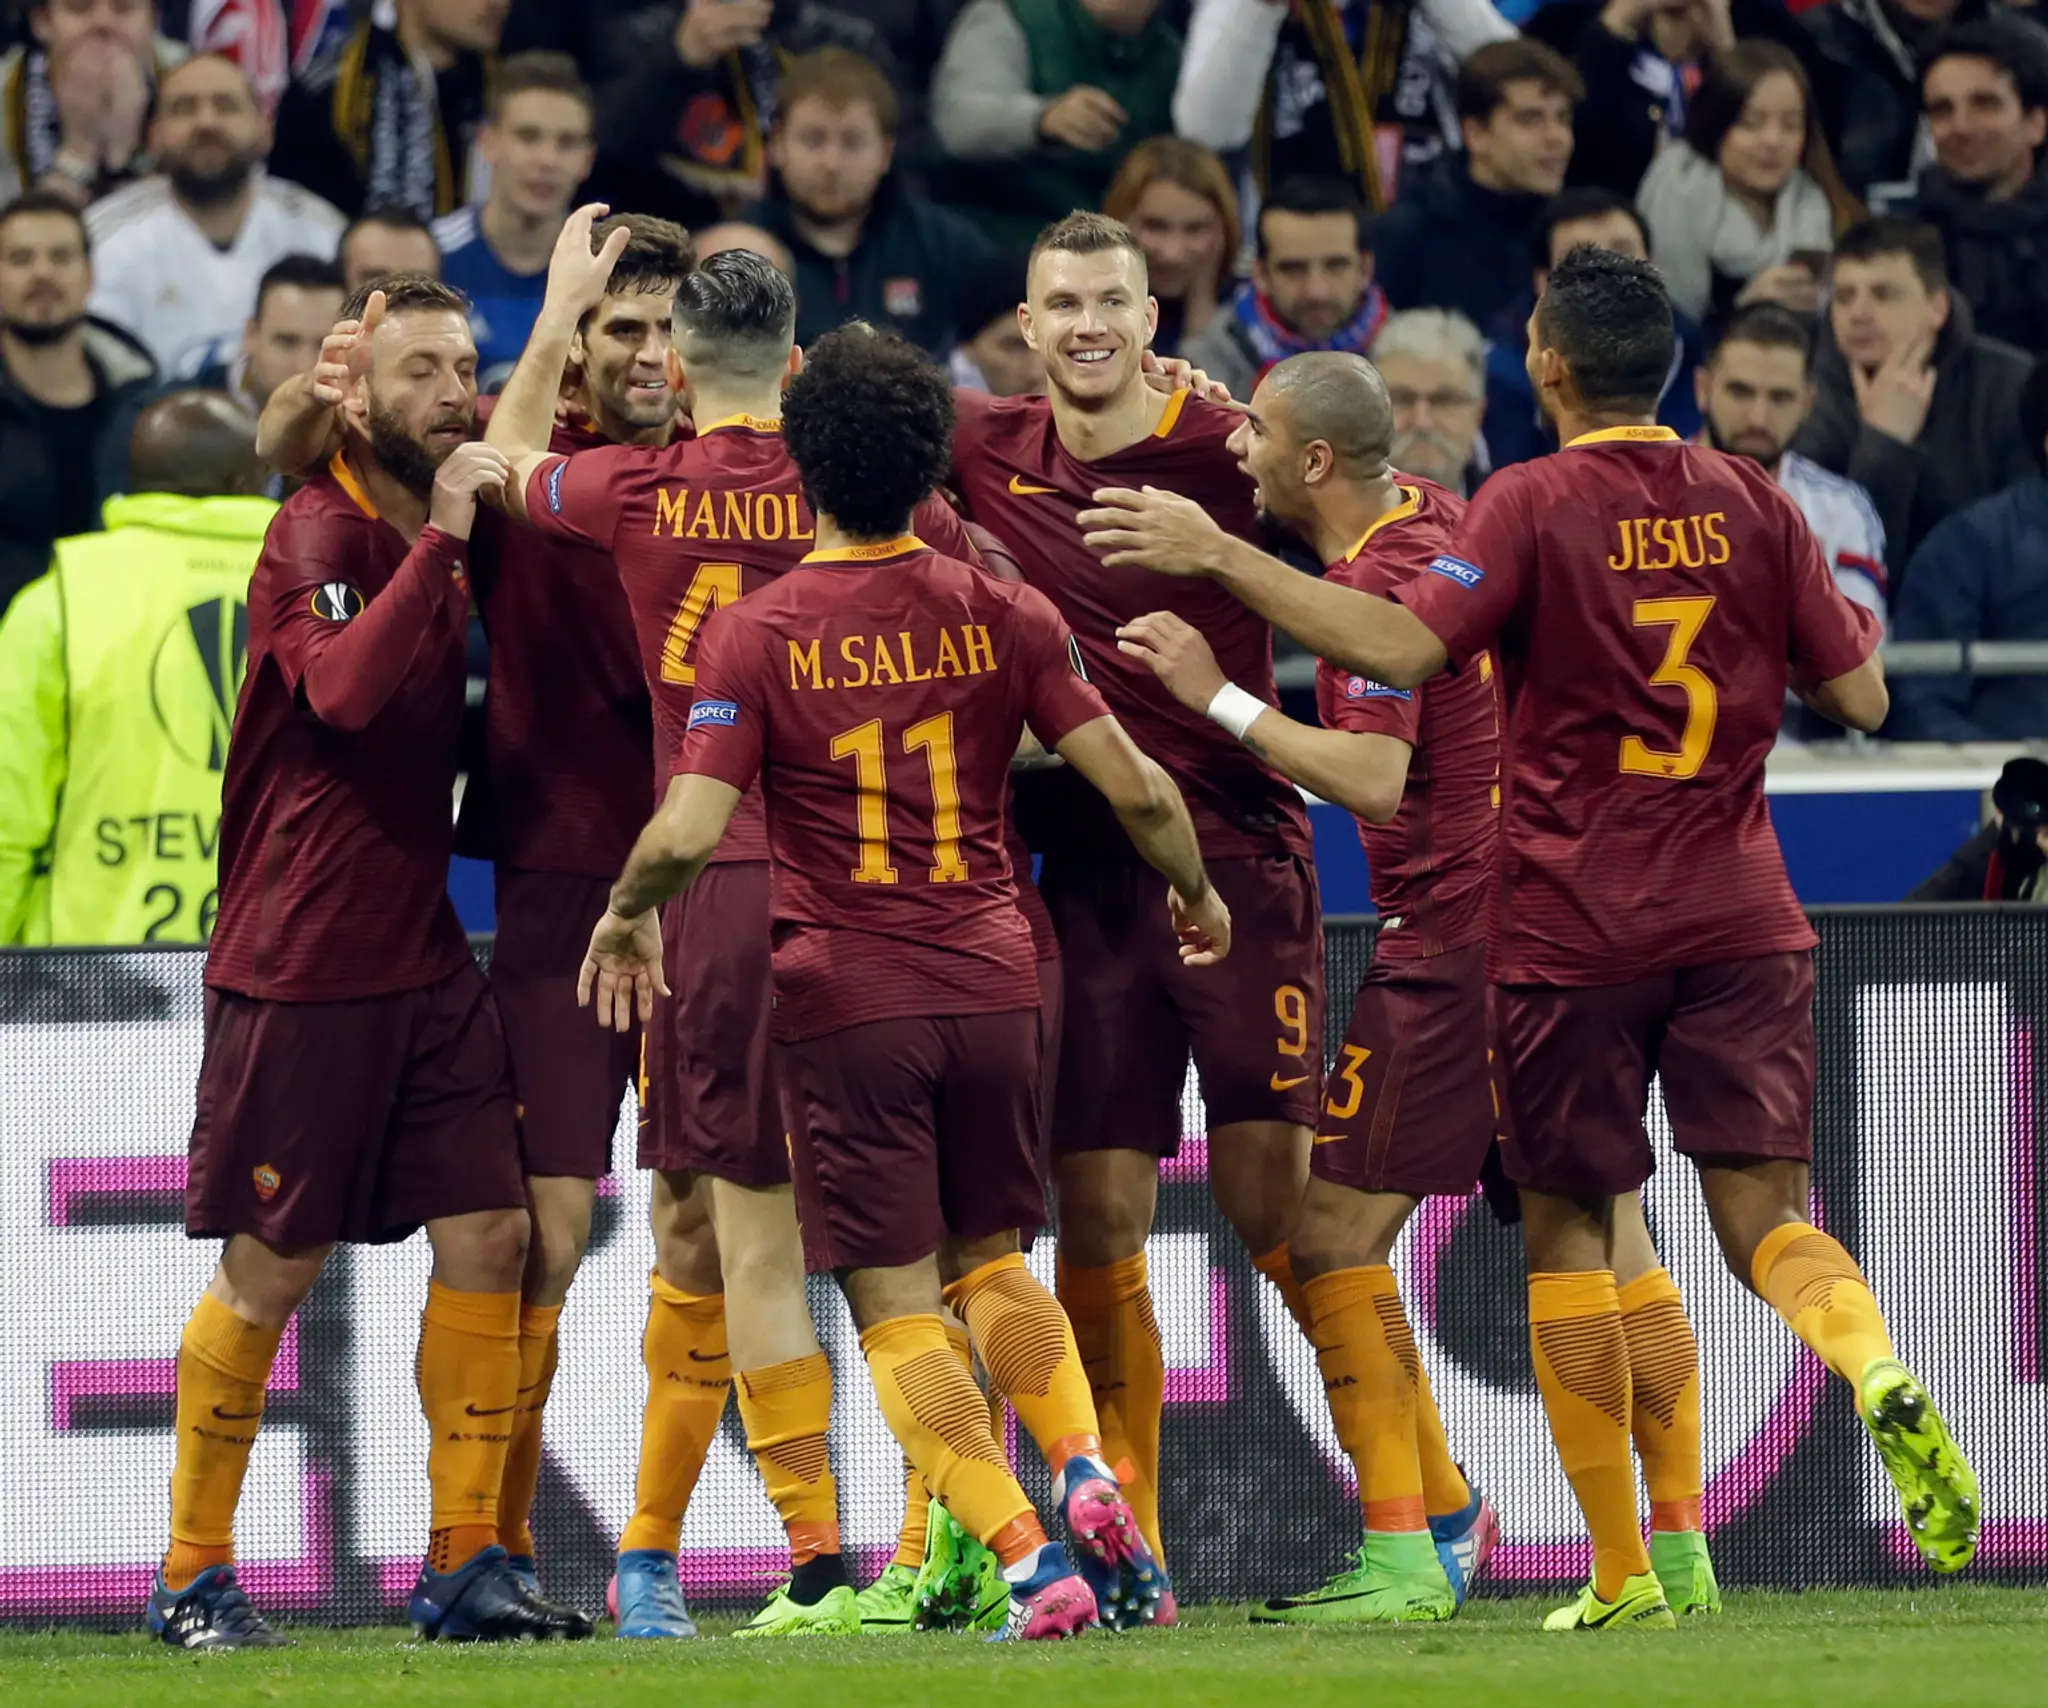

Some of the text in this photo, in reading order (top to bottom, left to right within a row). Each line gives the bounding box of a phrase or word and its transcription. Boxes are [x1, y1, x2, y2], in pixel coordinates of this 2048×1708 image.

[1608, 512, 1731, 571] JESUS
[660, 562, 742, 687] 4
[787, 624, 998, 691] M.SALAH
[1618, 595, 1718, 780] 3
[830, 710, 969, 885] 11
[1274, 984, 1308, 1057] 9
